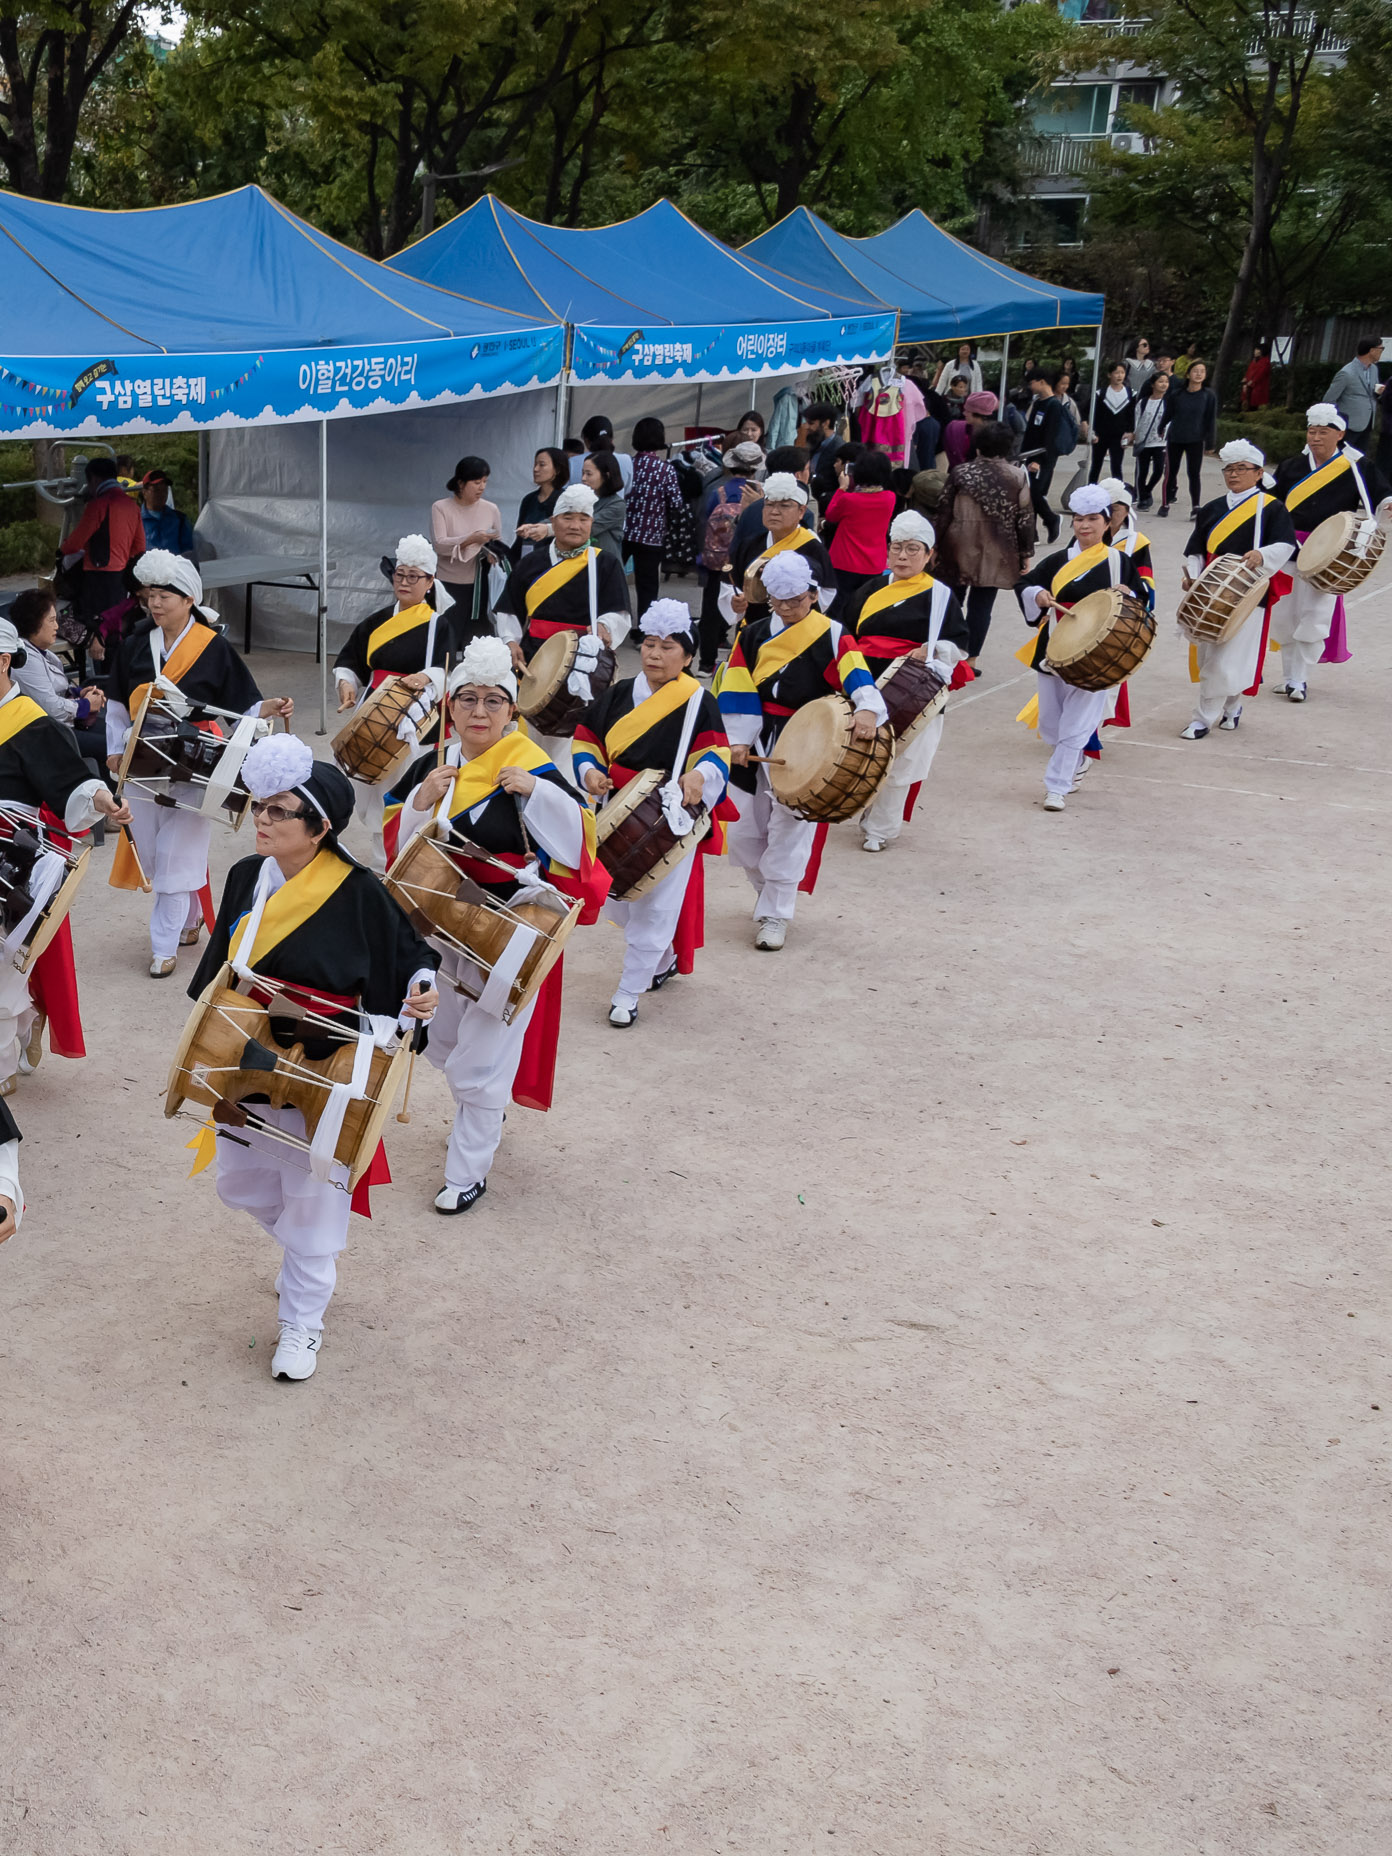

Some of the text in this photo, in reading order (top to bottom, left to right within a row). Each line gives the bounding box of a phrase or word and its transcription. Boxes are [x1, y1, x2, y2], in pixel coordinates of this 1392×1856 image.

[632, 342, 693, 366] 구삼열린축제
[737, 332, 788, 360] 어린이장터
[299, 353, 418, 394] 이혈건강동아리
[95, 376, 206, 410] 구삼열린축제
